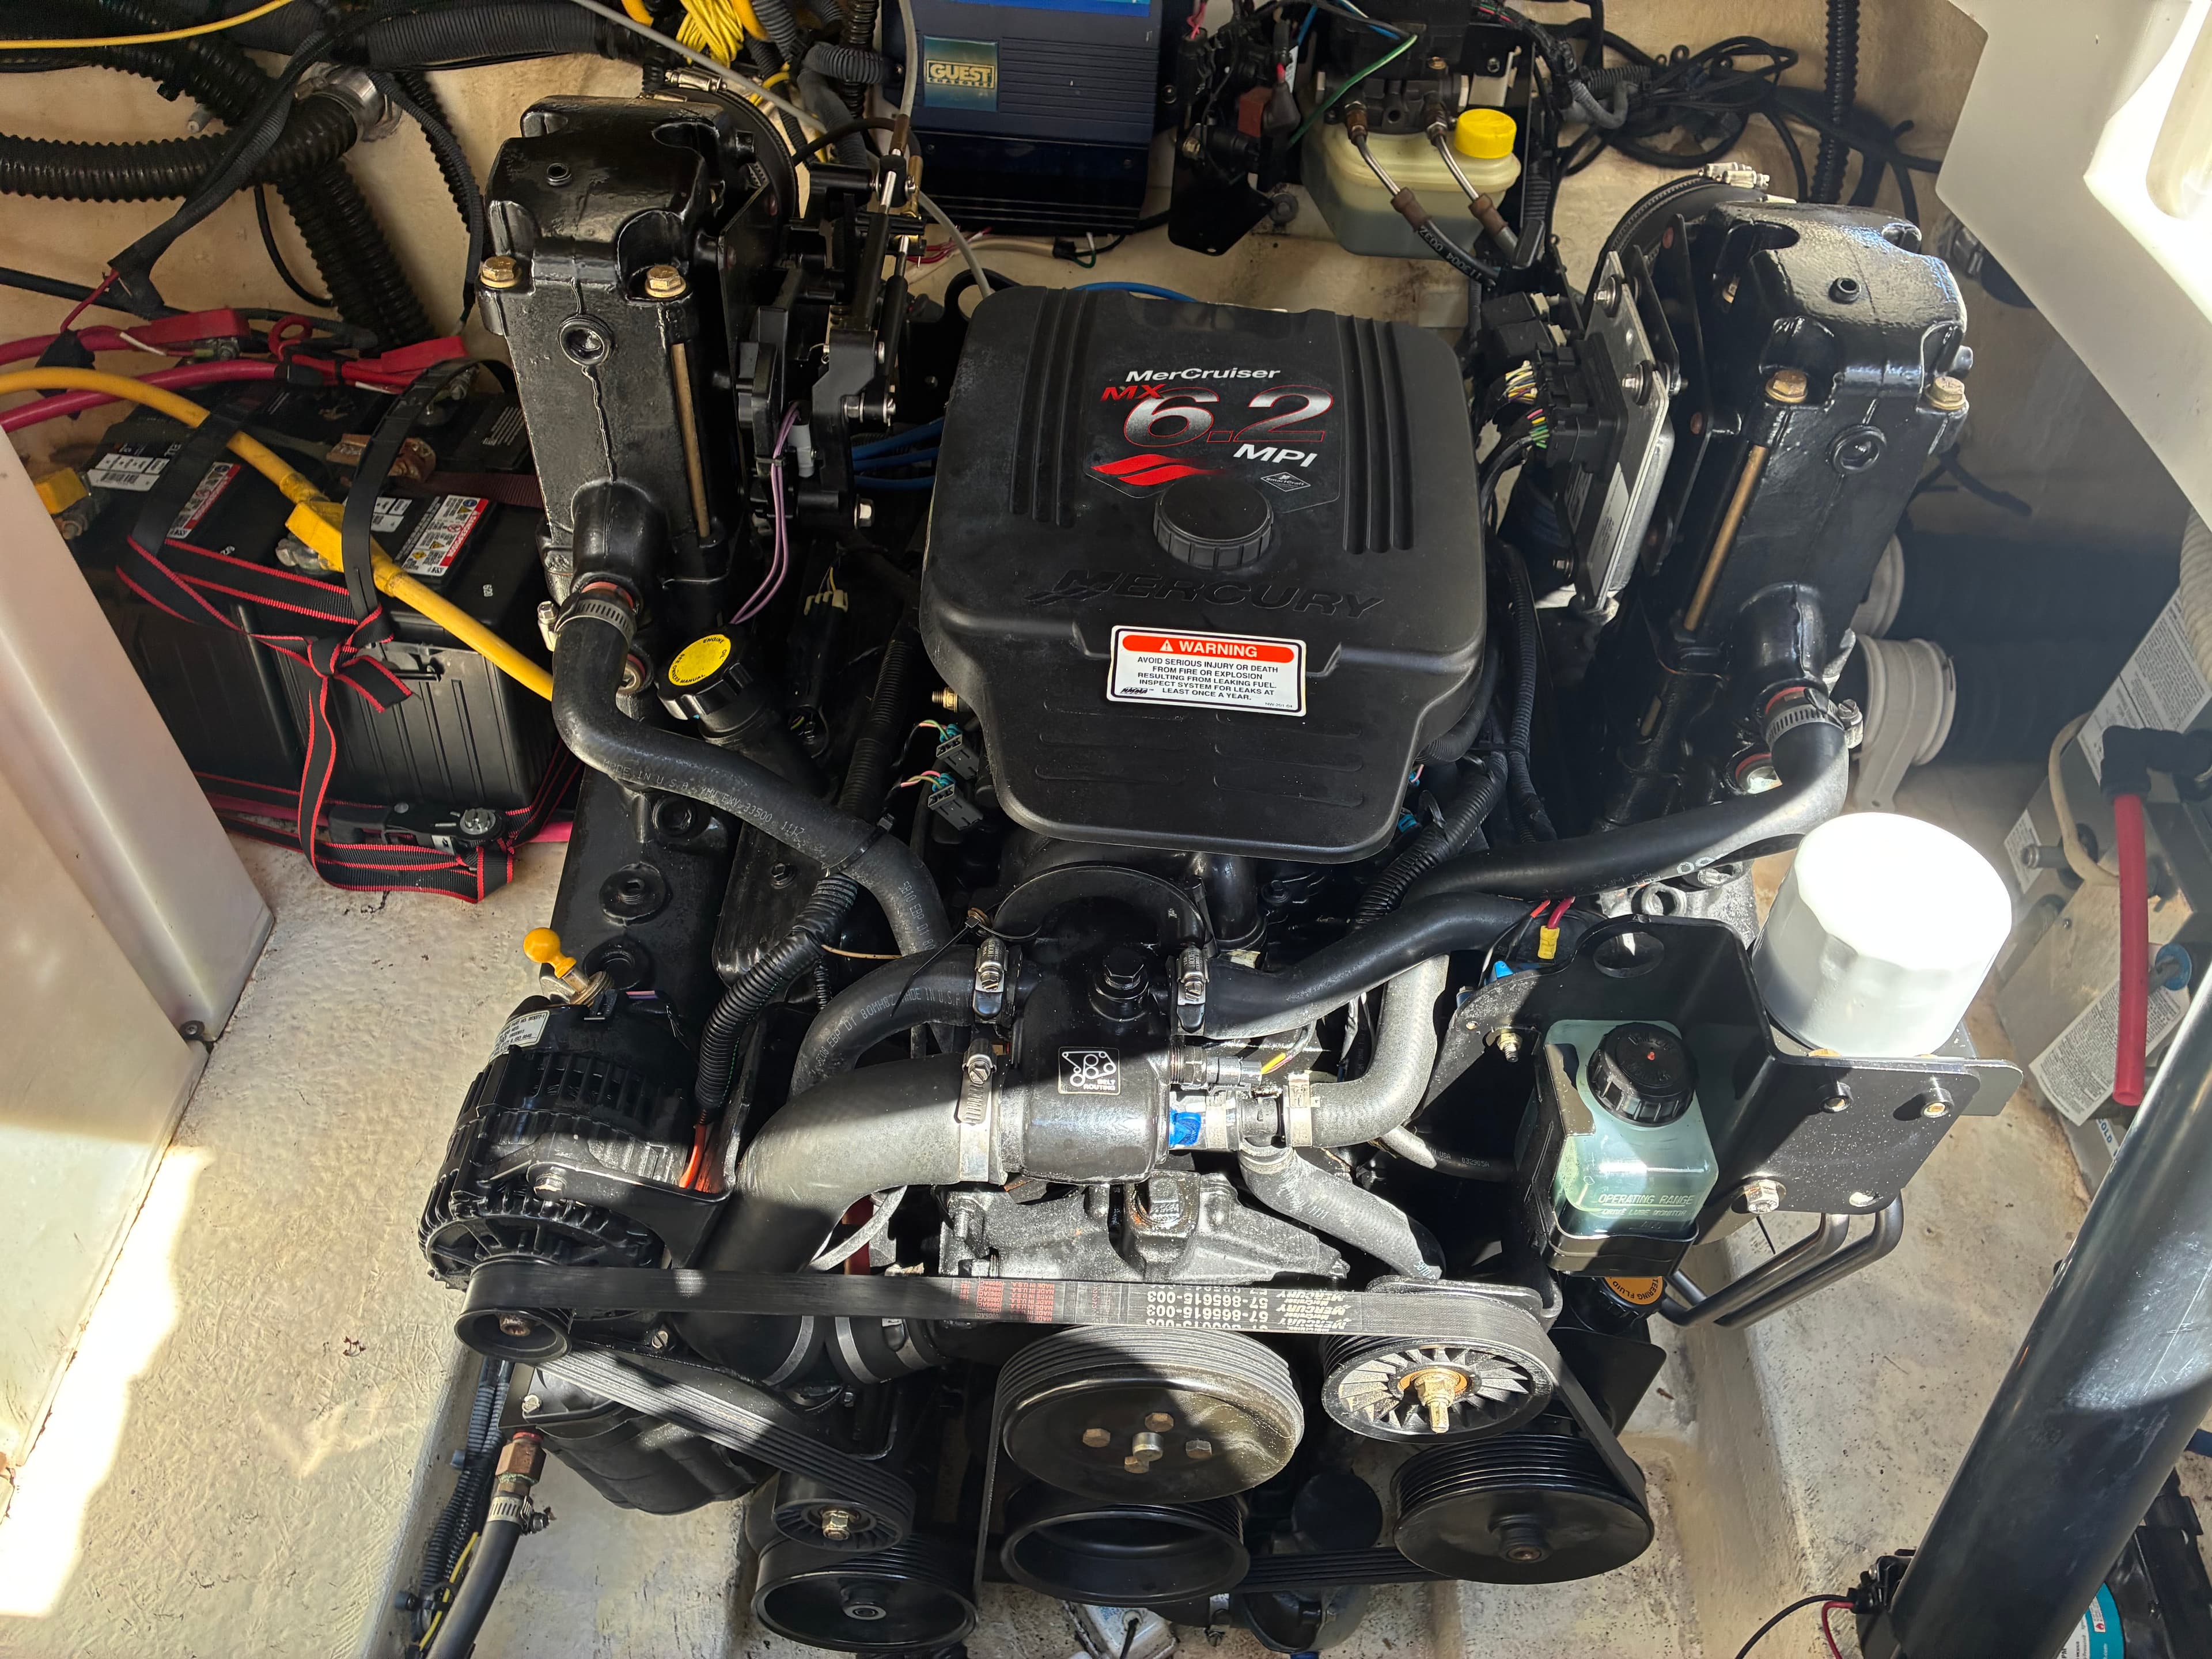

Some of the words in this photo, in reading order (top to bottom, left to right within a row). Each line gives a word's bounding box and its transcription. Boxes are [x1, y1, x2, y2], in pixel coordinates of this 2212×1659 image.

[930, 63, 991, 83] GUEST
[1126, 368, 1281, 382] MerCruiser
[1100, 384, 1167, 401] MX
[1124, 384, 1335, 448] 6.2
[1233, 444, 1318, 468] MPI
[1024, 570, 1385, 619] MERCURY
[1179, 641, 1257, 658] WARNING
[1165, 658, 1202, 668] SERIOUS
[1204, 661, 1234, 669] INJURY
[1251, 665, 1278, 673] DEATH
[1138, 672, 1185, 681] RESULTING
[1214, 678, 1251, 687] LEAKING
[1252, 681, 1277, 689] FUEL.
[1214, 670, 1263, 680] EXPLOSION
[1139, 679, 1175, 687] INSPECT
[1177, 681, 1217, 690] SYSTEM
[1234, 685, 1262, 694] LEAKS
[1191, 690, 1216, 698] ONCE
[1226, 692, 1252, 700] YEAR.
[826, 1028, 842, 1048] EBP
[1598, 1194, 1656, 1205] OPERATING
[1659, 1195, 1696, 1205] RANGE
[1276, 1291, 1346, 1301] MERCURY
[1612, 1281, 1635, 1299] FLUID
[1637, 1278, 1659, 1300] TEERING
[1147, 1291, 1268, 1309] 57-865615-003
[1146, 1304, 1268, 1323] 57-865615-003
[1275, 1304, 1346, 1316] MERCURY
